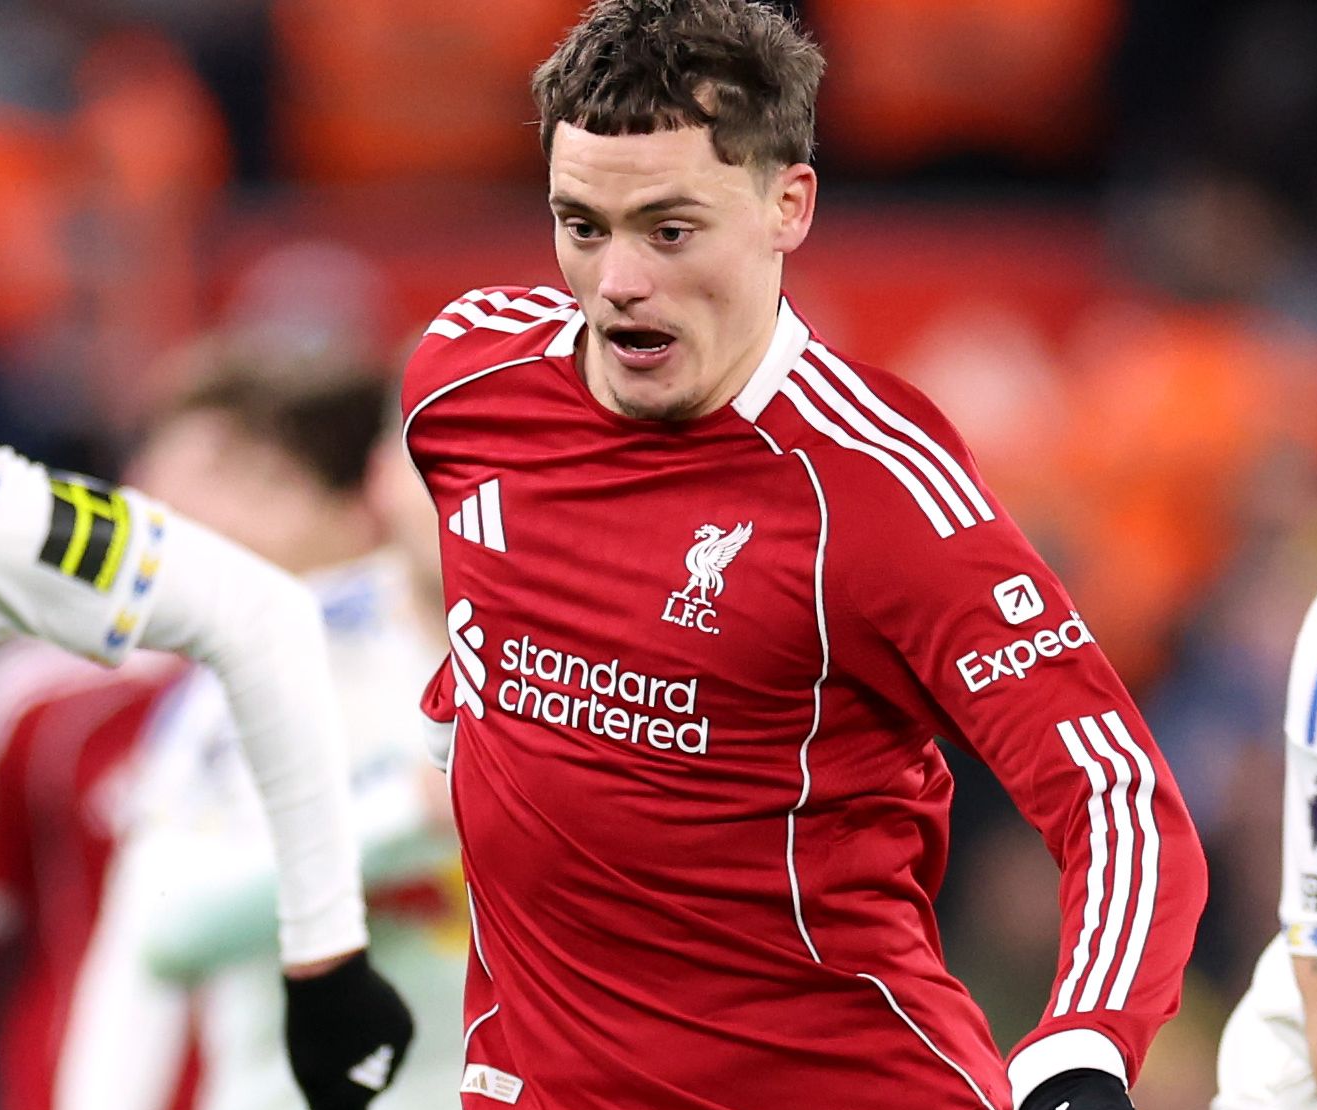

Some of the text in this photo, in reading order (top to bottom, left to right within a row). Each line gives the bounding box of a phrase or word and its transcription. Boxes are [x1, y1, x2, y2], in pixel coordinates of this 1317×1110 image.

[660, 597, 720, 635] L.F.C.
[499, 635, 698, 715] standard
[497, 676, 709, 755] chartered
